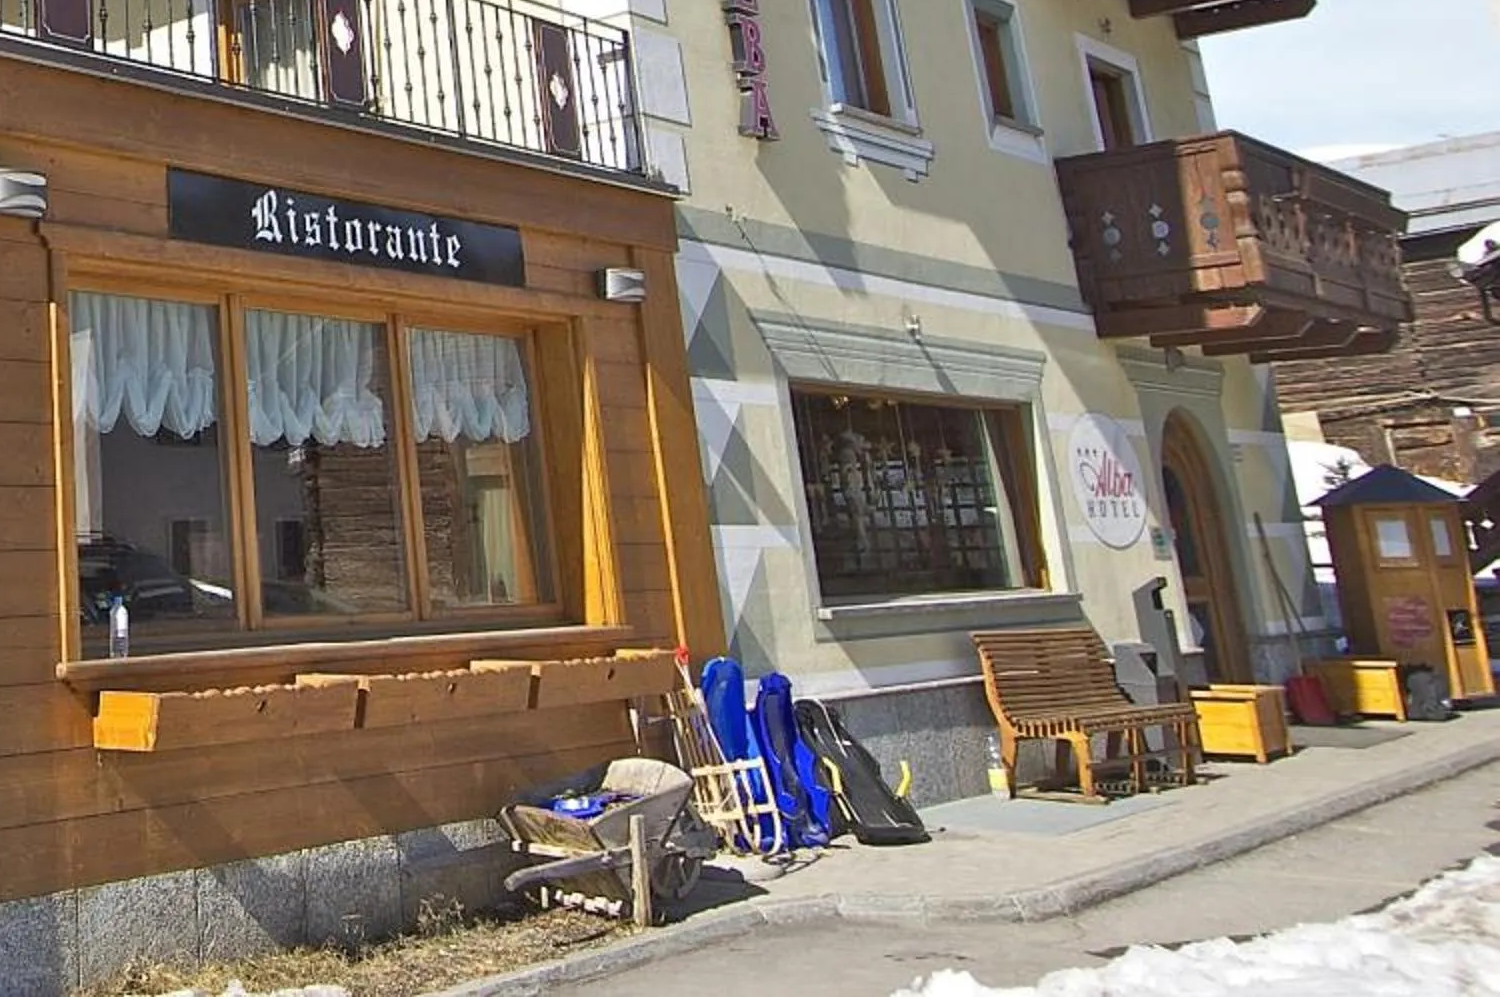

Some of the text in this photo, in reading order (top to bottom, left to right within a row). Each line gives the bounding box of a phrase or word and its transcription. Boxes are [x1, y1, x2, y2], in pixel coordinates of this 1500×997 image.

[251, 189, 463, 268] Ristorante
[1079, 450, 1135, 498] Alba
[1087, 500, 1140, 519] HOTEL
